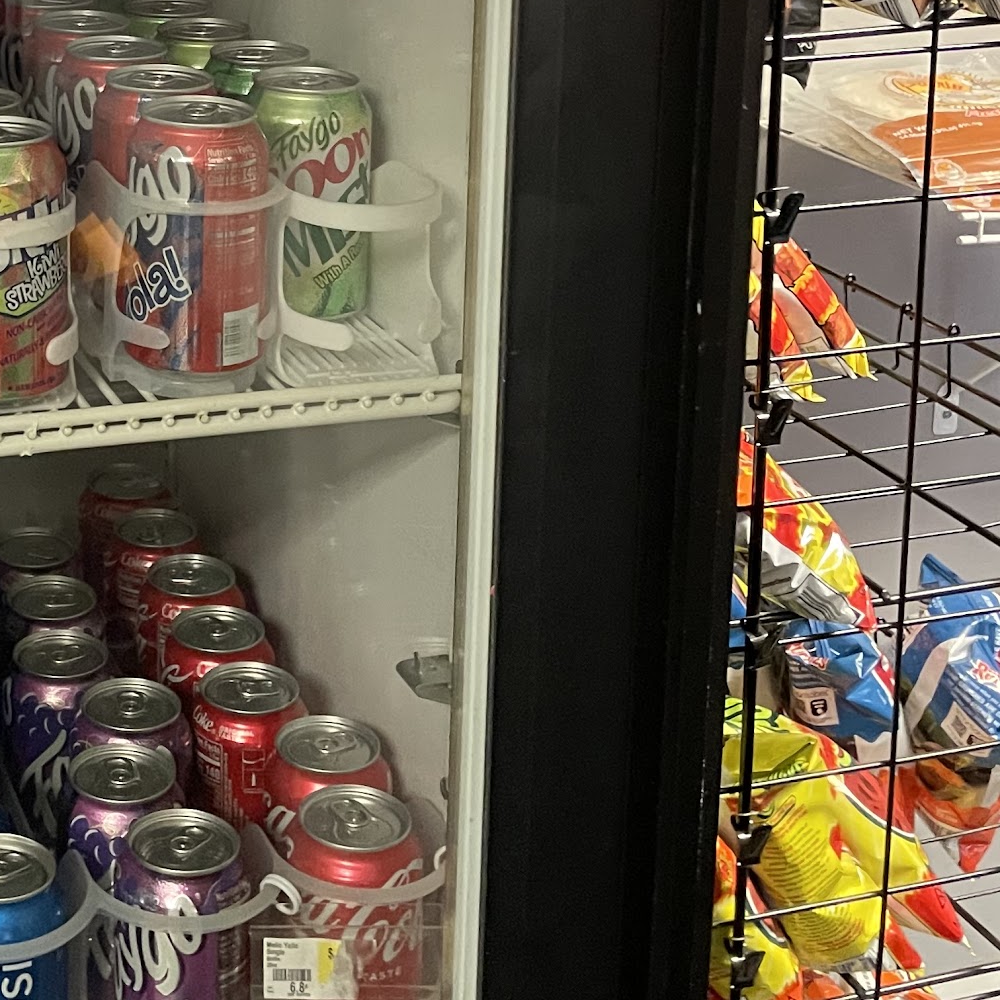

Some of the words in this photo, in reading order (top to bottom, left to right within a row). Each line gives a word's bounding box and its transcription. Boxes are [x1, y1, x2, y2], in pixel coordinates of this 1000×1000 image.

[271, 111, 341, 172] Faygo
[126, 246, 193, 323] ola!
[313, 263, 343, 290] With
[192, 704, 214, 732] Coke
